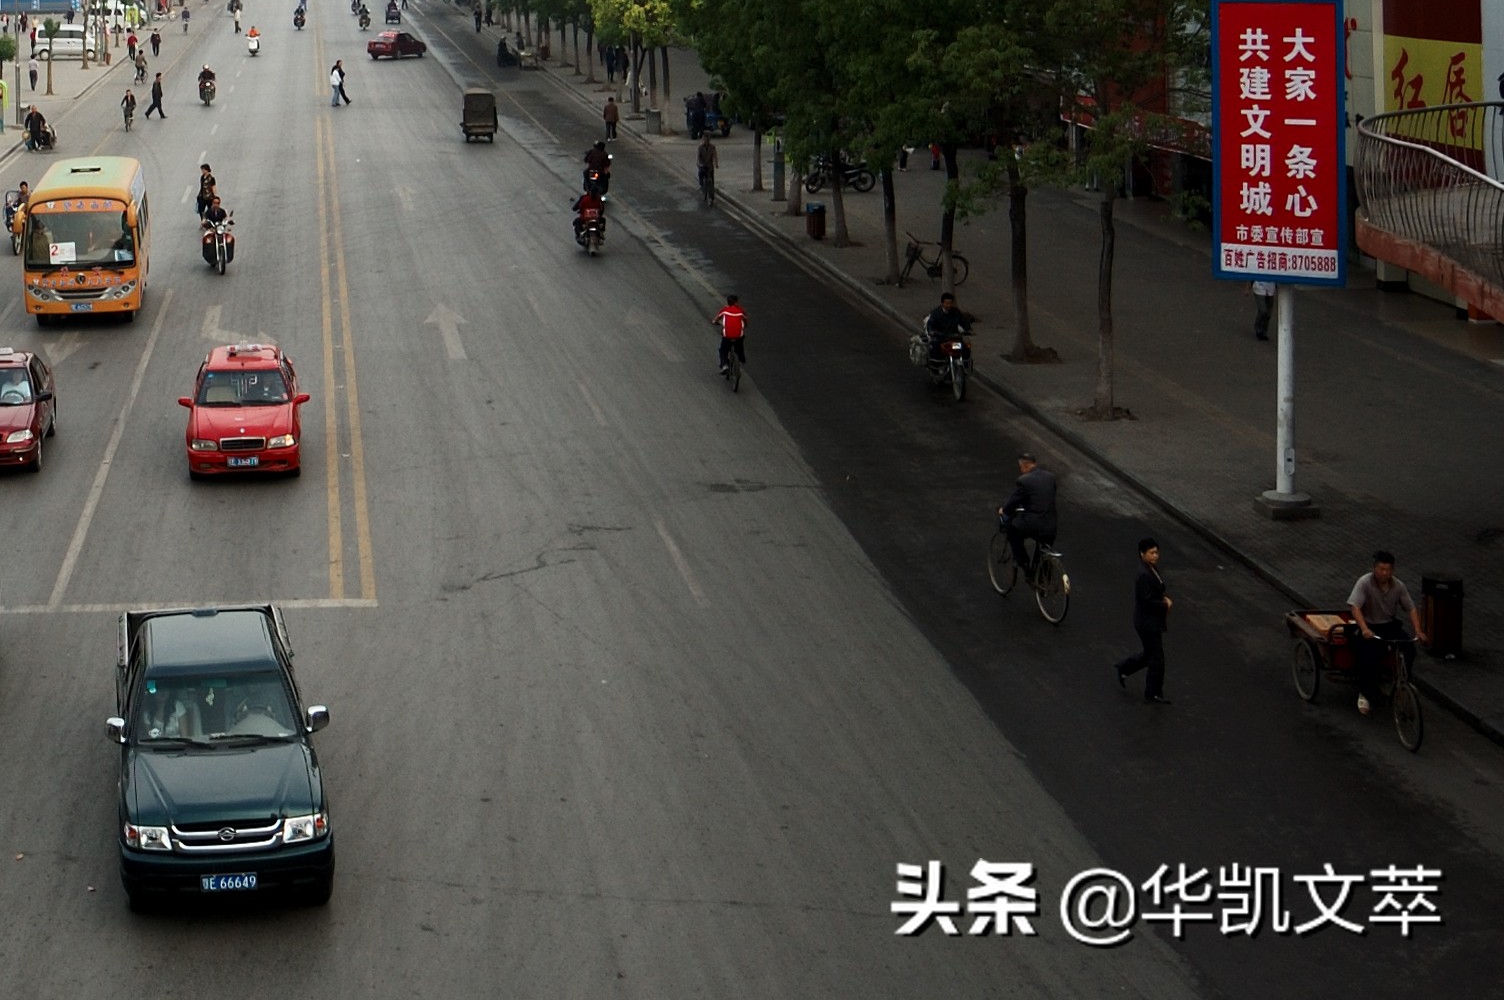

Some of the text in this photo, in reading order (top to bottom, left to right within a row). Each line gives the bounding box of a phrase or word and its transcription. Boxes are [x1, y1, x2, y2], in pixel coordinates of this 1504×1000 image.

[1238, 27, 1273, 217] 共建文明城
[1282, 27, 1318, 218] 大家一条心
[1235, 224, 1325, 247] 市委宣传部宣
[50, 244, 59, 256] 2
[220, 875, 256, 889] 66649
